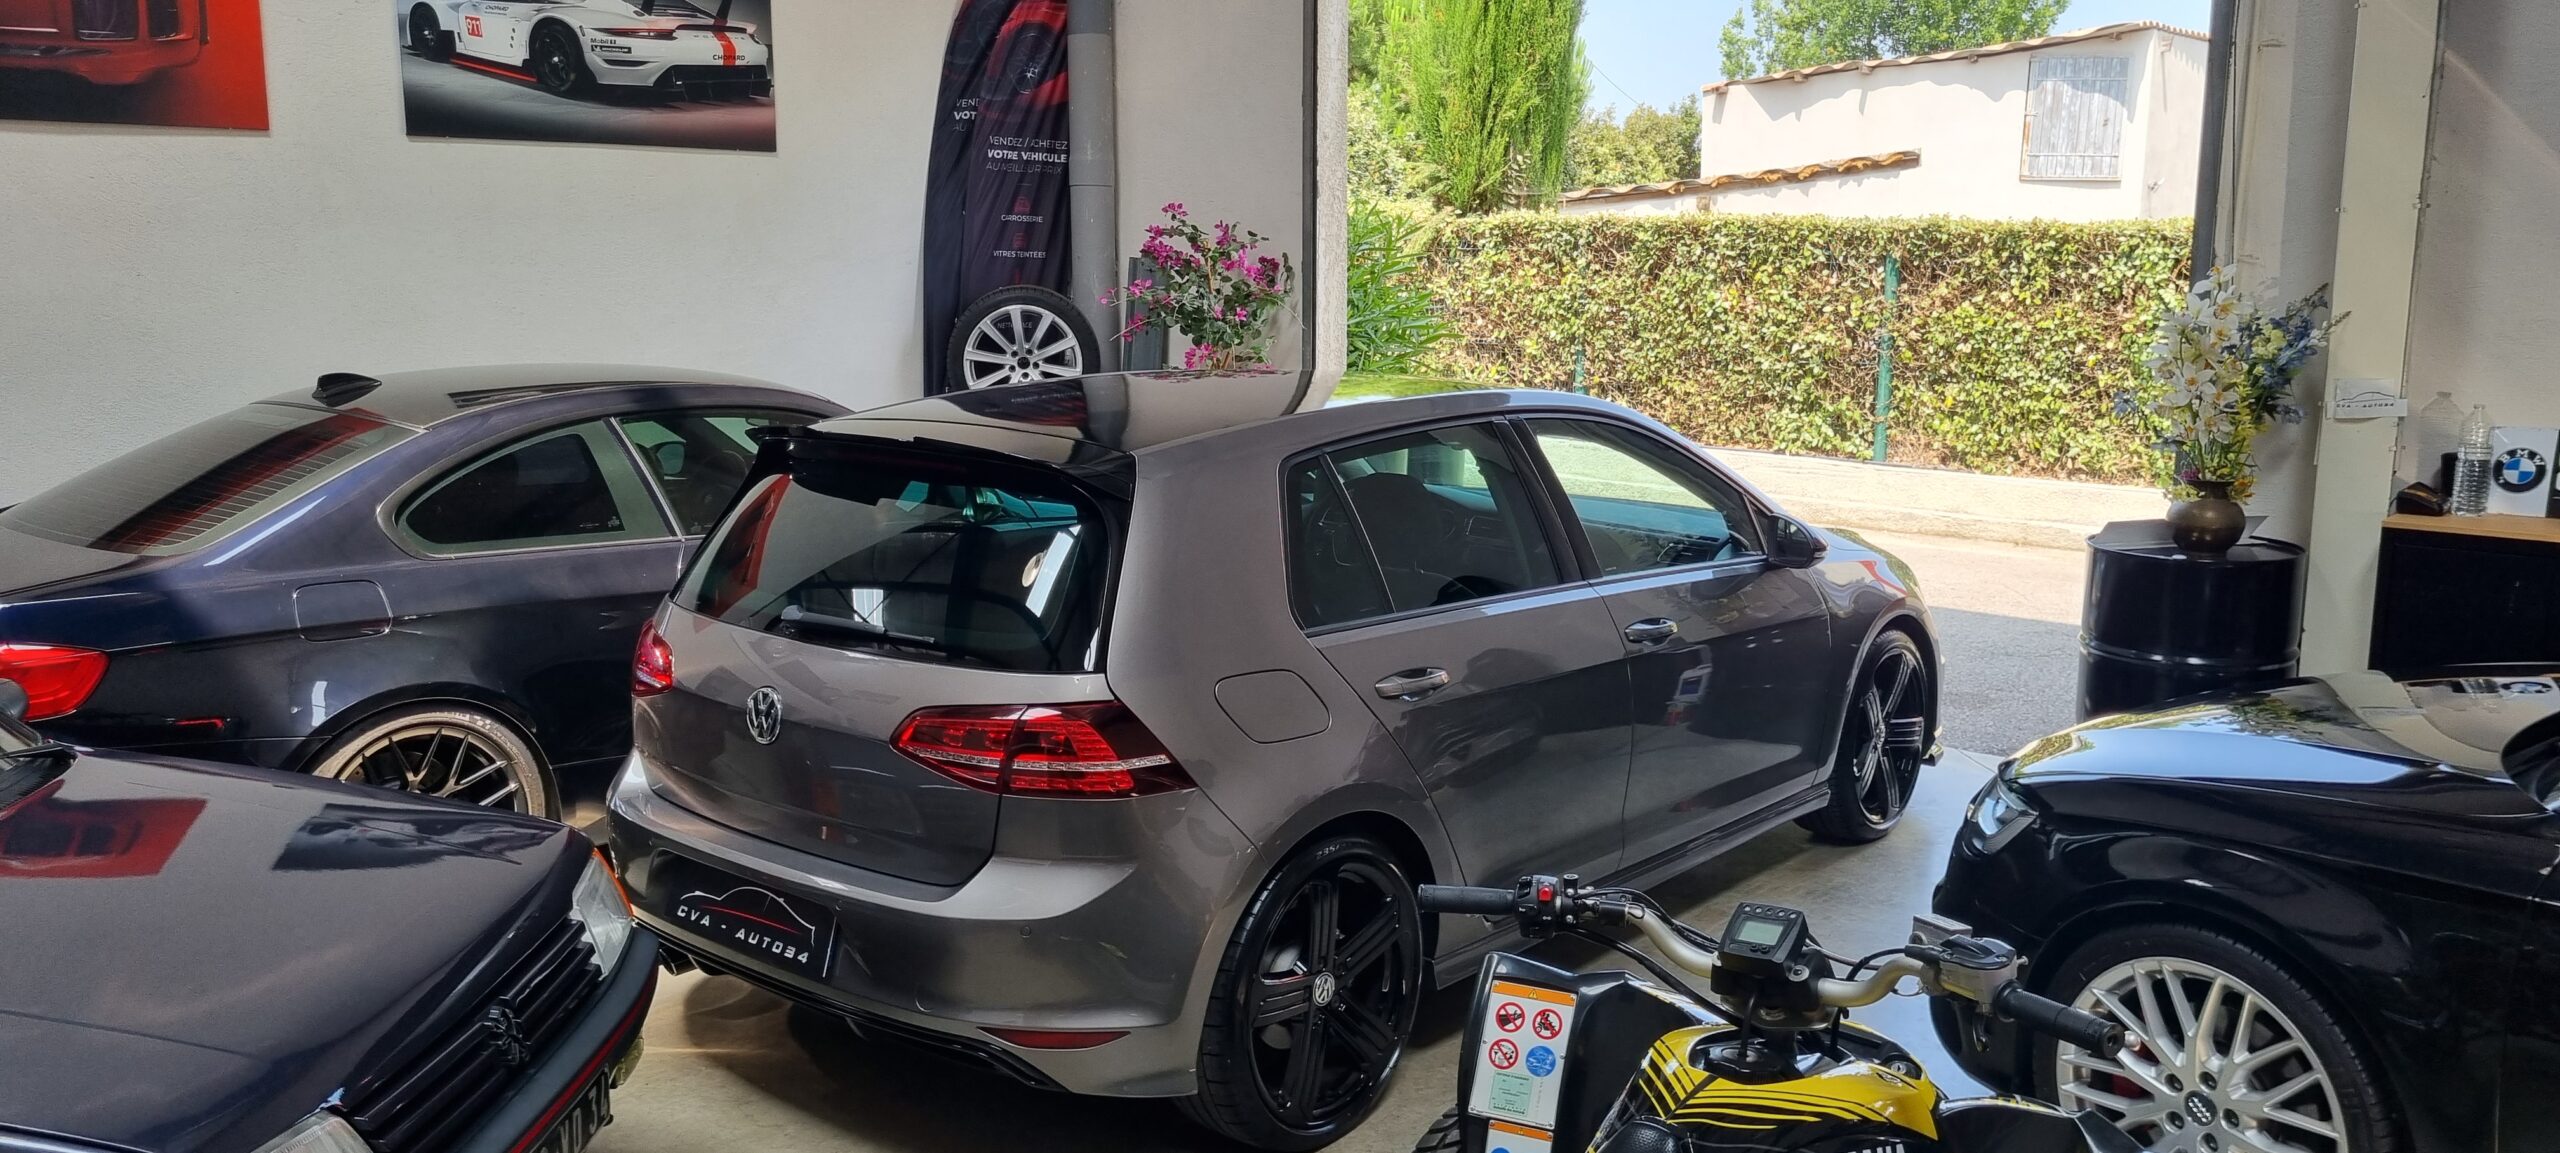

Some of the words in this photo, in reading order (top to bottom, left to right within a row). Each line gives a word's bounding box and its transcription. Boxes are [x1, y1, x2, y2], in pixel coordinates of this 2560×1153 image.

[466, 18, 482, 36] 911
[990, 136, 1022, 147] VENDEZ
[987, 149, 1018, 160] VOTRE
[993, 250, 1016, 258] VITRES
[676, 905, 710, 927] CVA
[735, 928, 809, 964] AUTO34
